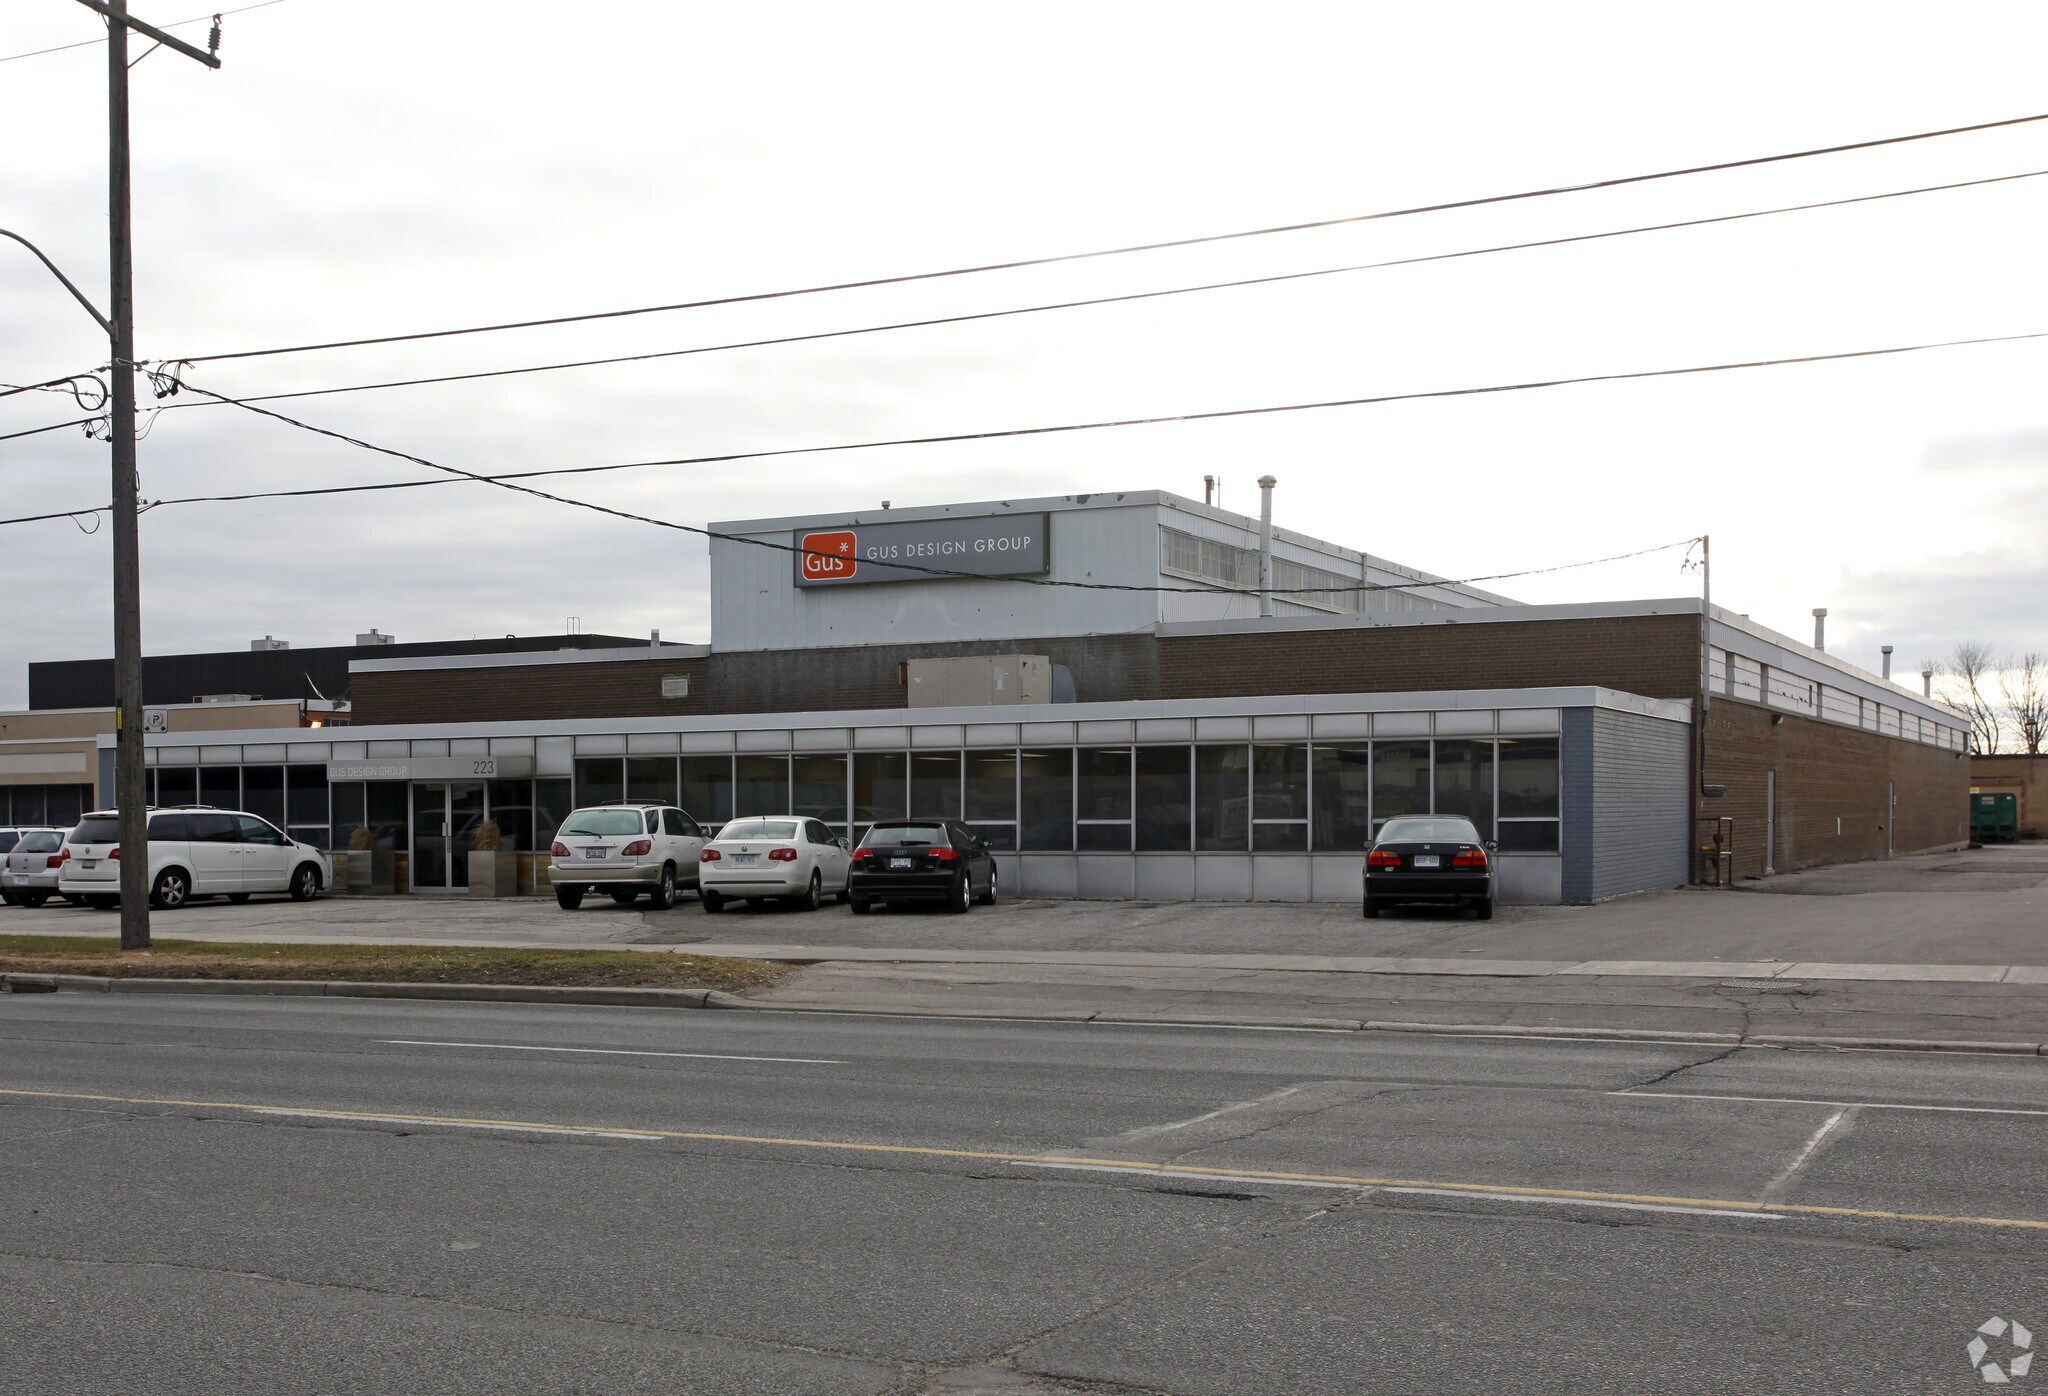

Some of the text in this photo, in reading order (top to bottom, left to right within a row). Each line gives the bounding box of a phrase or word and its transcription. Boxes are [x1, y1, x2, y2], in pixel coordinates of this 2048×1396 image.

[867, 536, 1031, 560] GUS DESIGN GROUP
[329, 766, 407, 777] GUS DESIGN GROUP
[473, 760, 494, 774] 223
